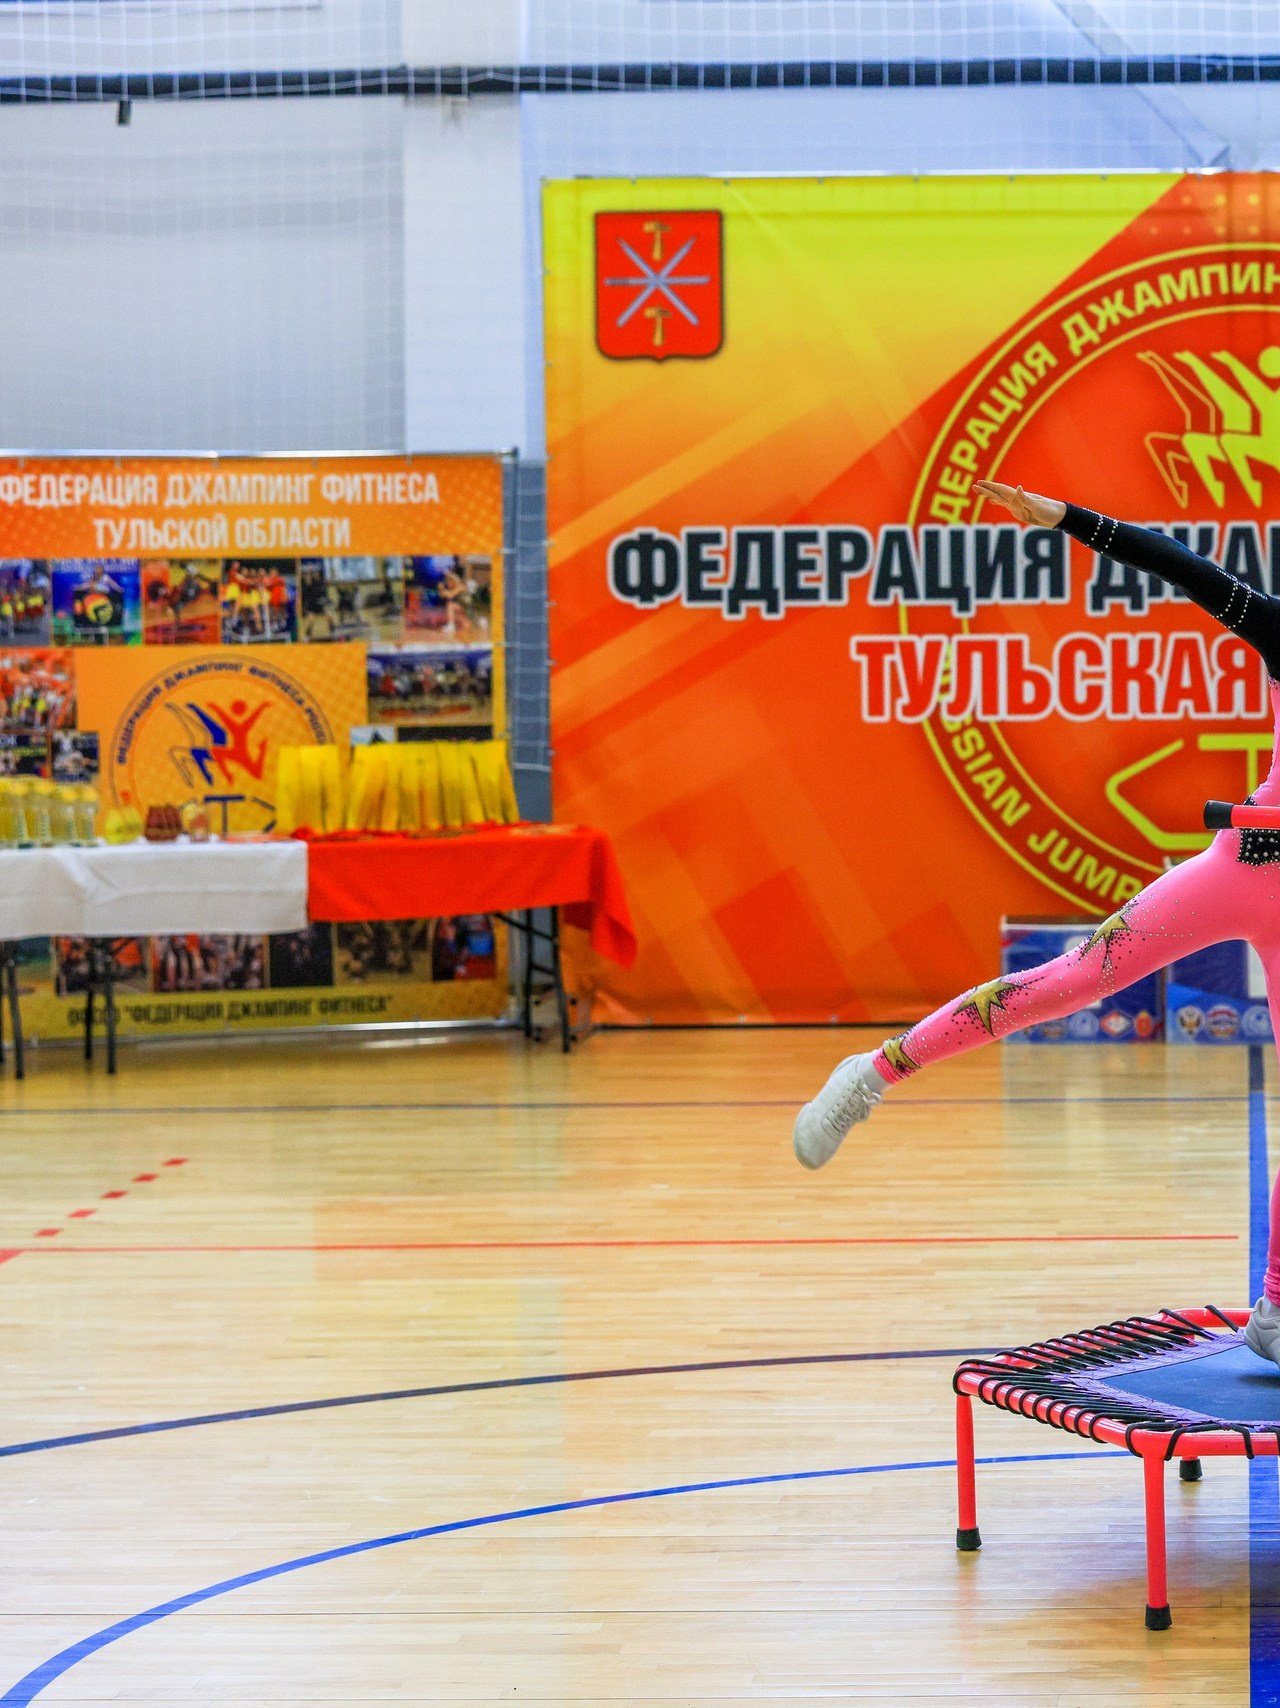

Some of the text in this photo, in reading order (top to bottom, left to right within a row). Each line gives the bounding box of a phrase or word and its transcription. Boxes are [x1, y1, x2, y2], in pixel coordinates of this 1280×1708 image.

[930, 340, 1058, 524] ДЕРАЦИЯ
[0, 472, 439, 508] ФЕДЕРАЦИЯ ДЖАМПИНГ ФИТНЕСА
[93, 513, 351, 550] ТУЛЬСКОЙ ОБЛАСТИ
[608, 524, 1071, 619] ФЕДЕРАЦИЯ
[851, 634, 1267, 722] ТУЛЬСКАЯ
[1026, 829, 1144, 904] JUMP
